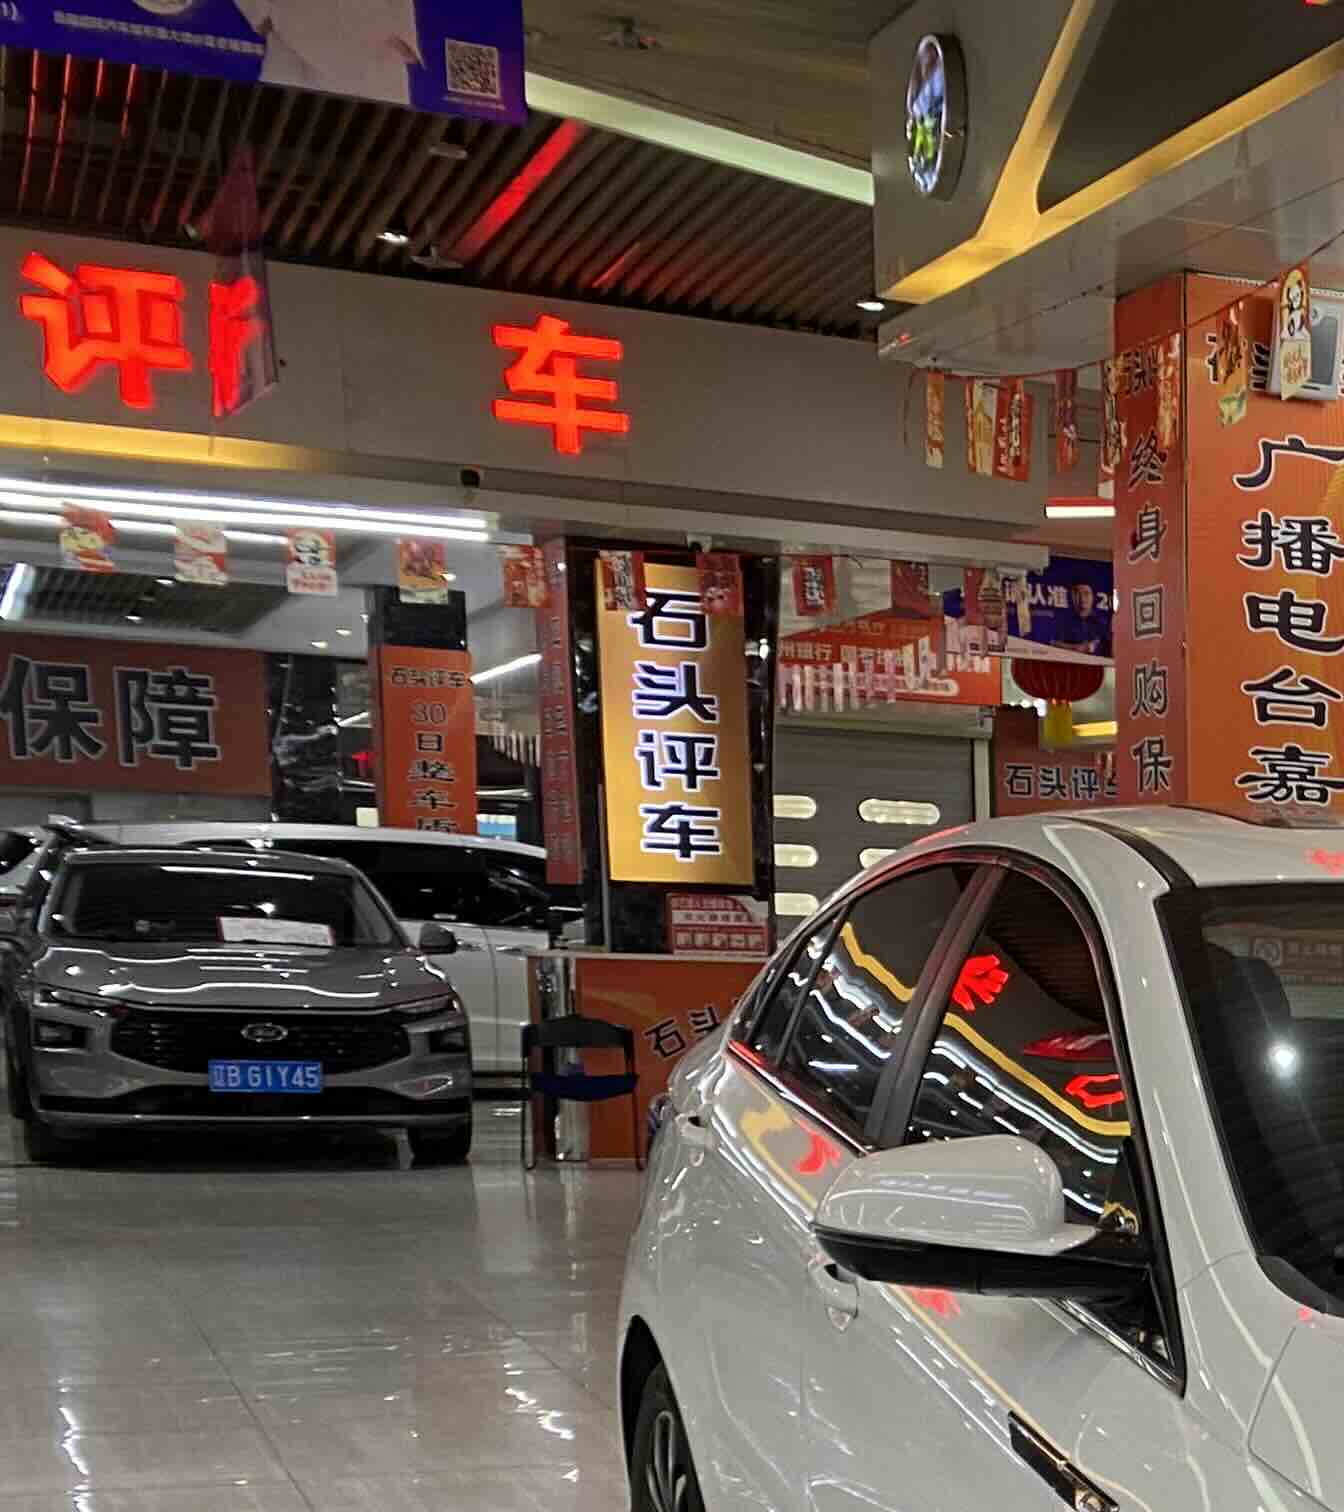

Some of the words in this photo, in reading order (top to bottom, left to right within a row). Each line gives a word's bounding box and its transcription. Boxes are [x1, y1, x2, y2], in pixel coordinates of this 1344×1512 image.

[490, 312, 631, 456] 车
[0, 654, 221, 771] 保障
[628, 586, 723, 862] 石头评车
